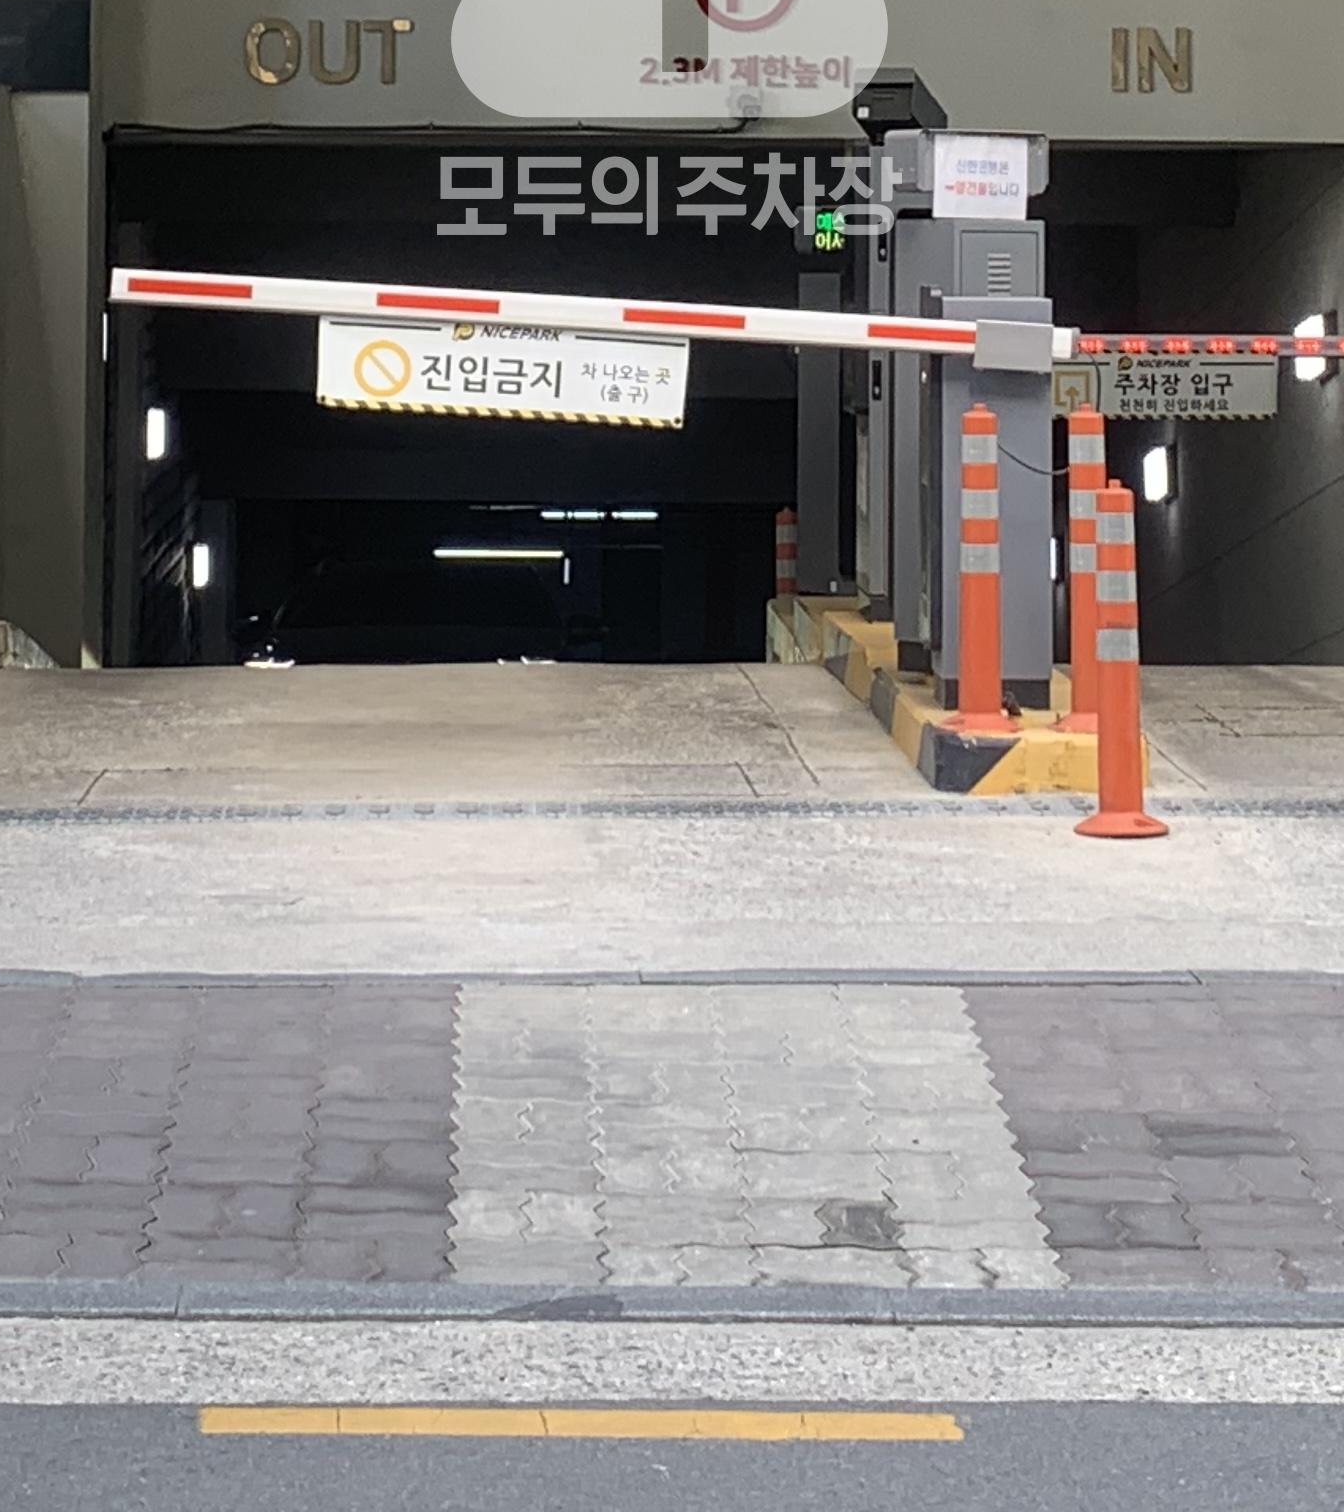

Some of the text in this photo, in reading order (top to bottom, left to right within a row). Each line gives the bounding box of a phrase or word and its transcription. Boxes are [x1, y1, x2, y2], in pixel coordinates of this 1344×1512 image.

[245, 18, 414, 85] OUT
[1112, 27, 1192, 93] IN
[640, 54, 851, 89] 2.3M 제한높이
[479, 325, 563, 342] NICEPARK
[581, 362, 671, 386] 차 나오는 곳
[1136, 359, 1192, 368] NICEPARK
[420, 354, 563, 398] 진입금지
[1114, 373, 1234, 396] 주차장 입구
[1119, 398, 1230, 412] 천천히 진입하세요
